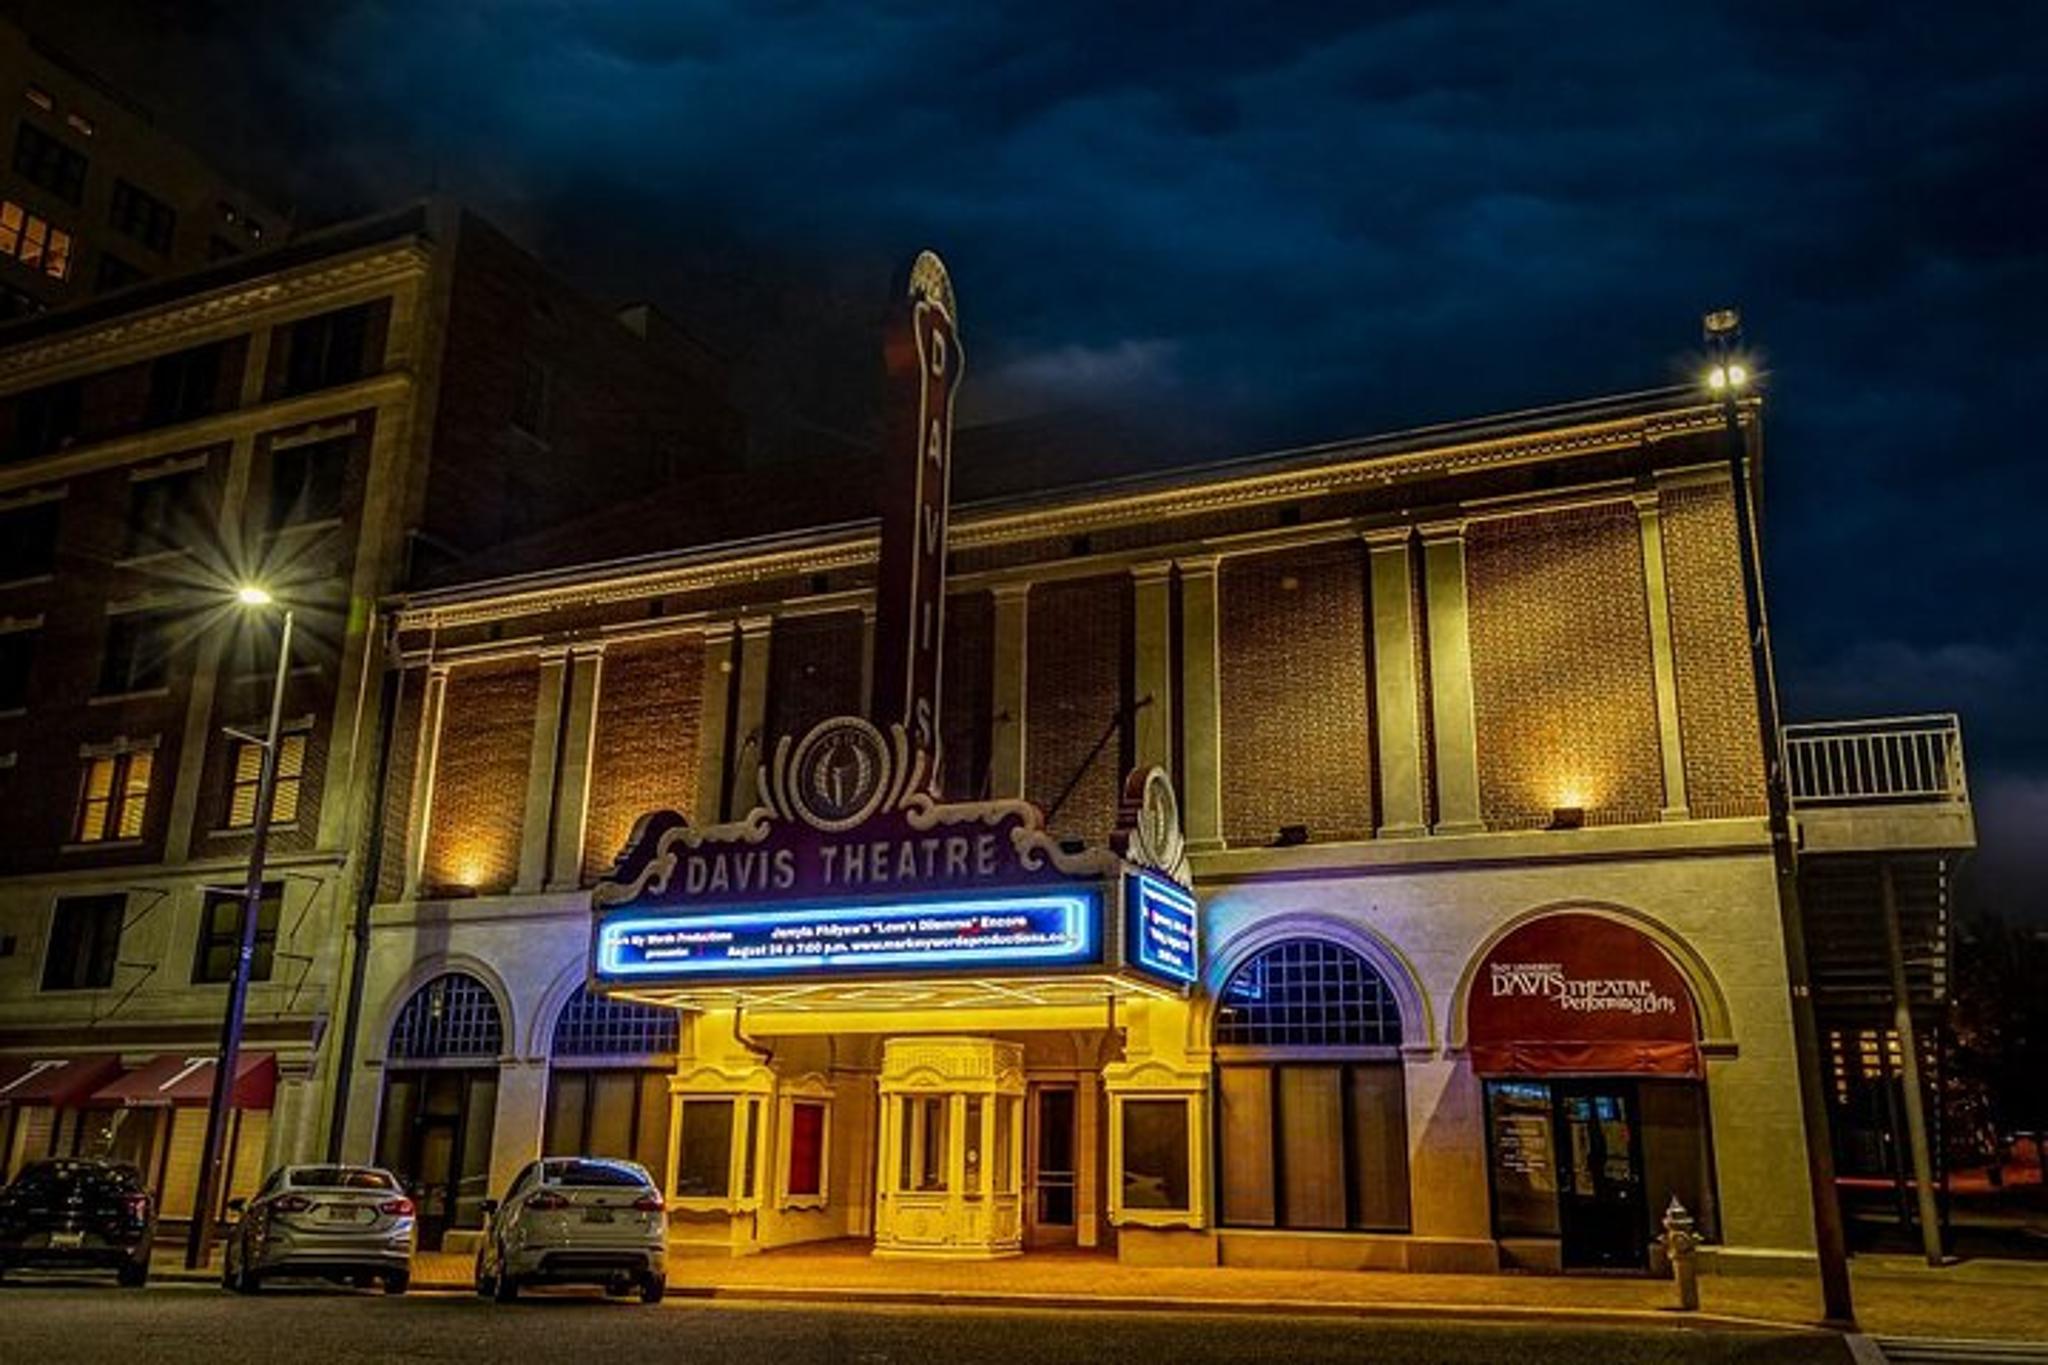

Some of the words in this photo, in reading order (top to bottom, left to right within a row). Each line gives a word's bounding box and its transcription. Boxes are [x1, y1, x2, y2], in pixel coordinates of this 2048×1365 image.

[915, 328, 947, 740] DAVIS
[686, 848, 796, 895] DAVIS
[820, 834, 998, 885] THEATRE
[981, 915, 1028, 929] Encore
[727, 944, 766, 959] August
[1491, 971, 1565, 1000] DAVIS
[1565, 980, 1651, 997] THEATRE
[1560, 993, 1643, 1014] Performing
